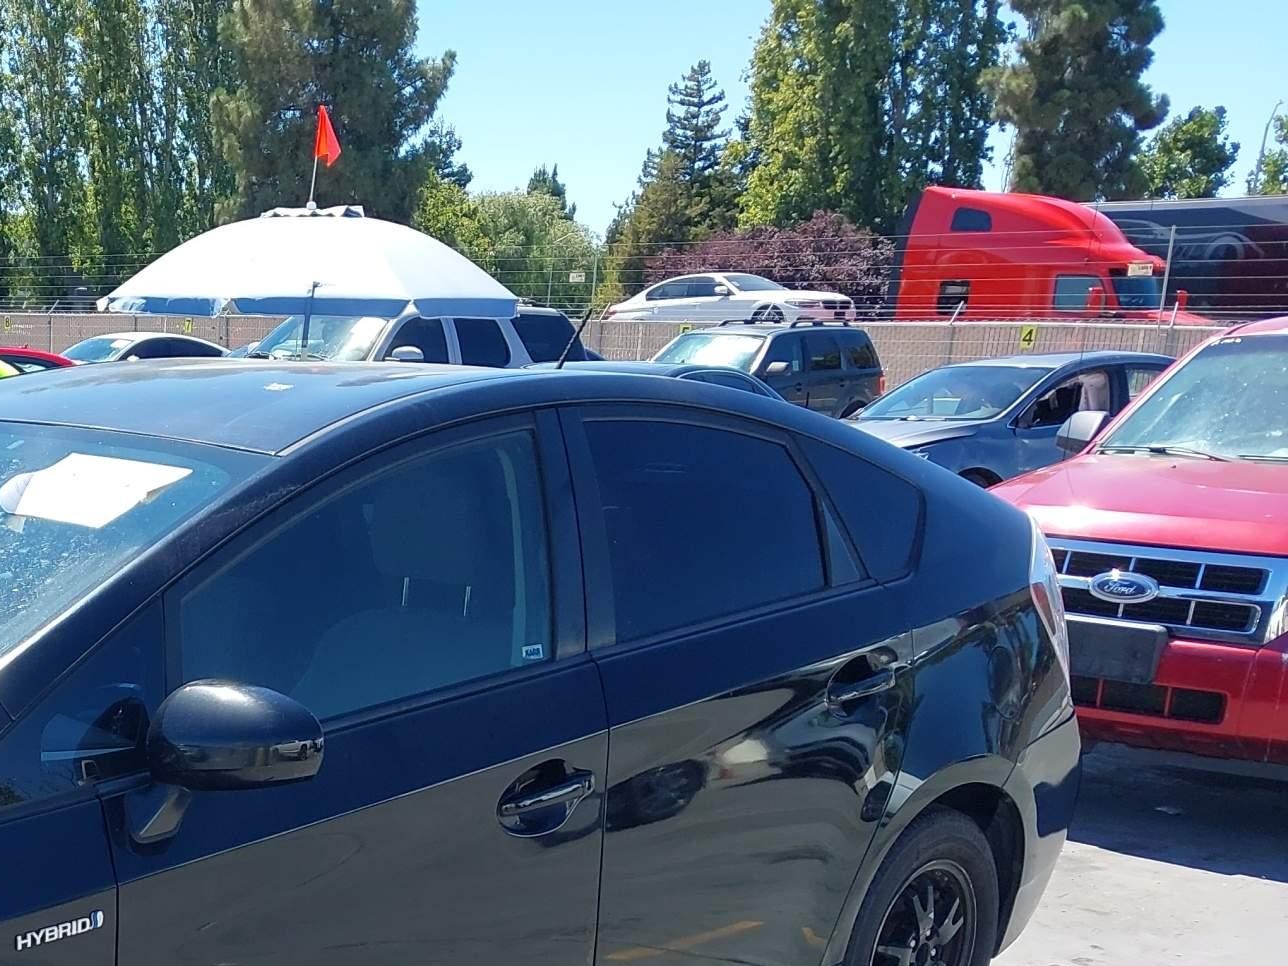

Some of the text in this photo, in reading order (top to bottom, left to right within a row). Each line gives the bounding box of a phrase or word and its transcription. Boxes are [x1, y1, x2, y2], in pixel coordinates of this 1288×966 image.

[1022, 328, 1034, 346] 4
[1103, 581, 1137, 595] Ford
[16, 917, 93, 951] HYBRID
